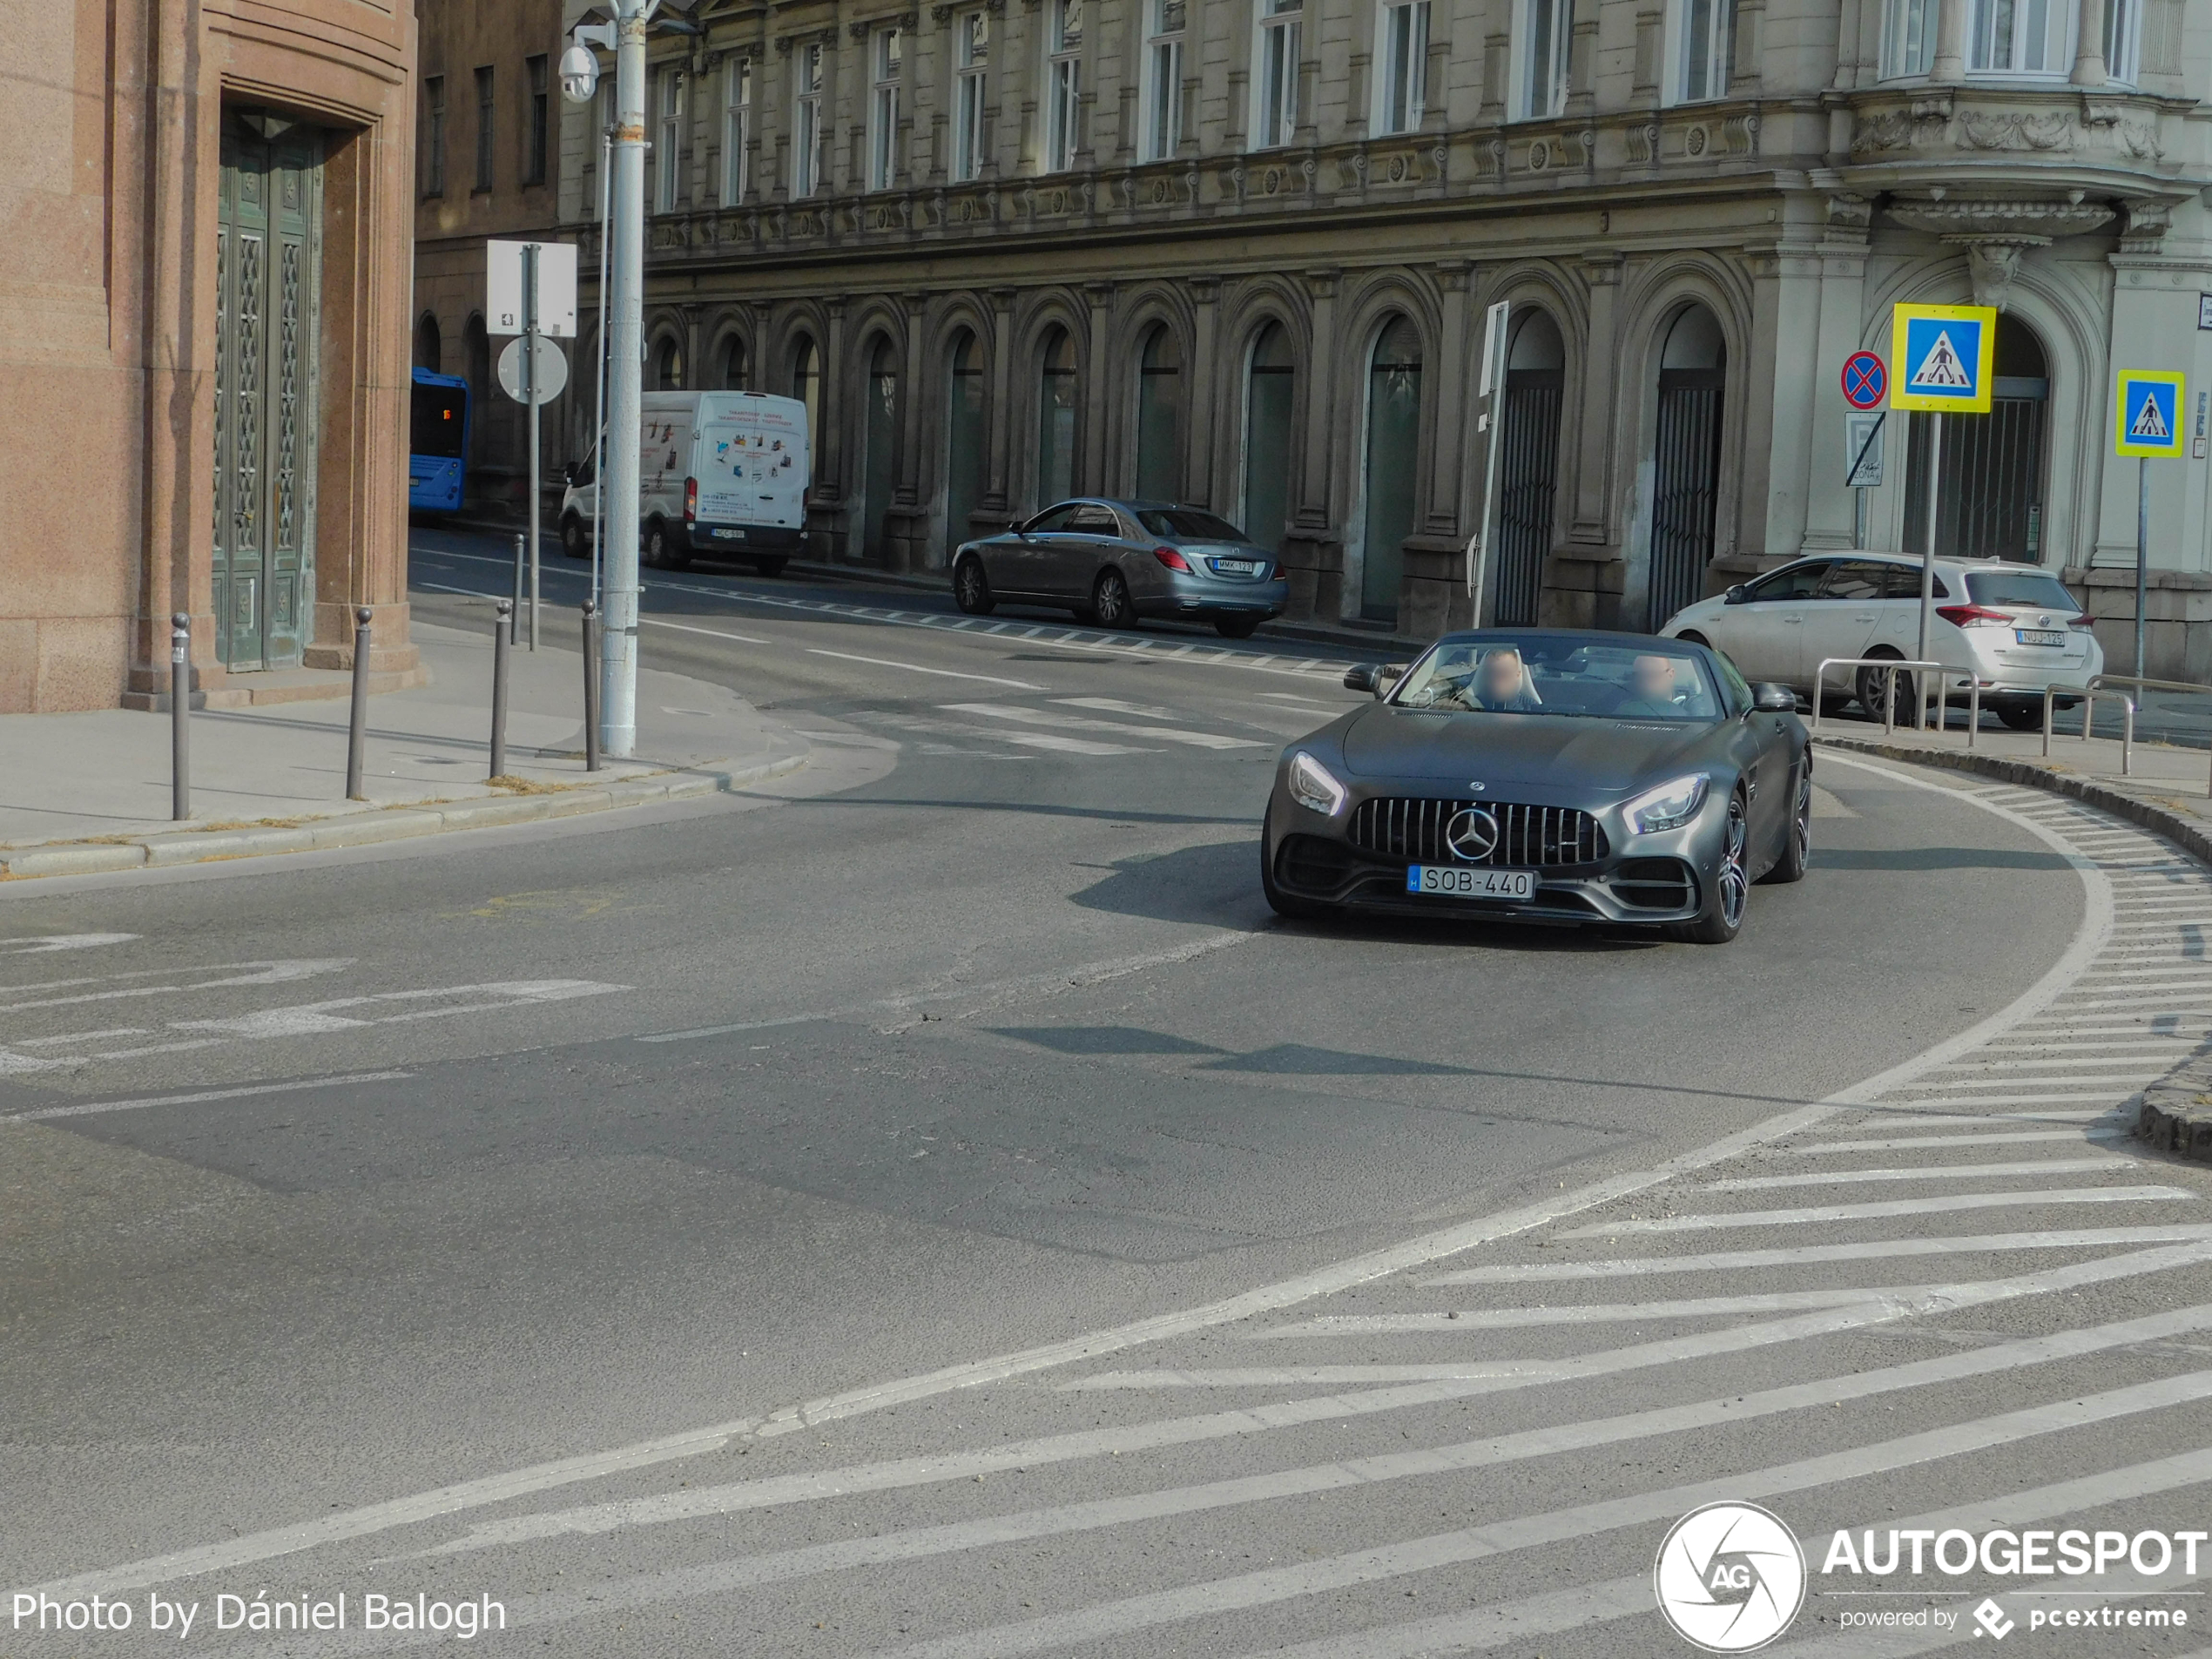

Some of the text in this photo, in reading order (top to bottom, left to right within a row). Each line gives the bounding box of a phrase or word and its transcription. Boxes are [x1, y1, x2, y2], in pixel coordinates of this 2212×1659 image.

[1219, 560, 1251, 570] MMK-123
[2024, 632, 2063, 644] NUJ-125
[1425, 869, 1527, 895] SOB-440
